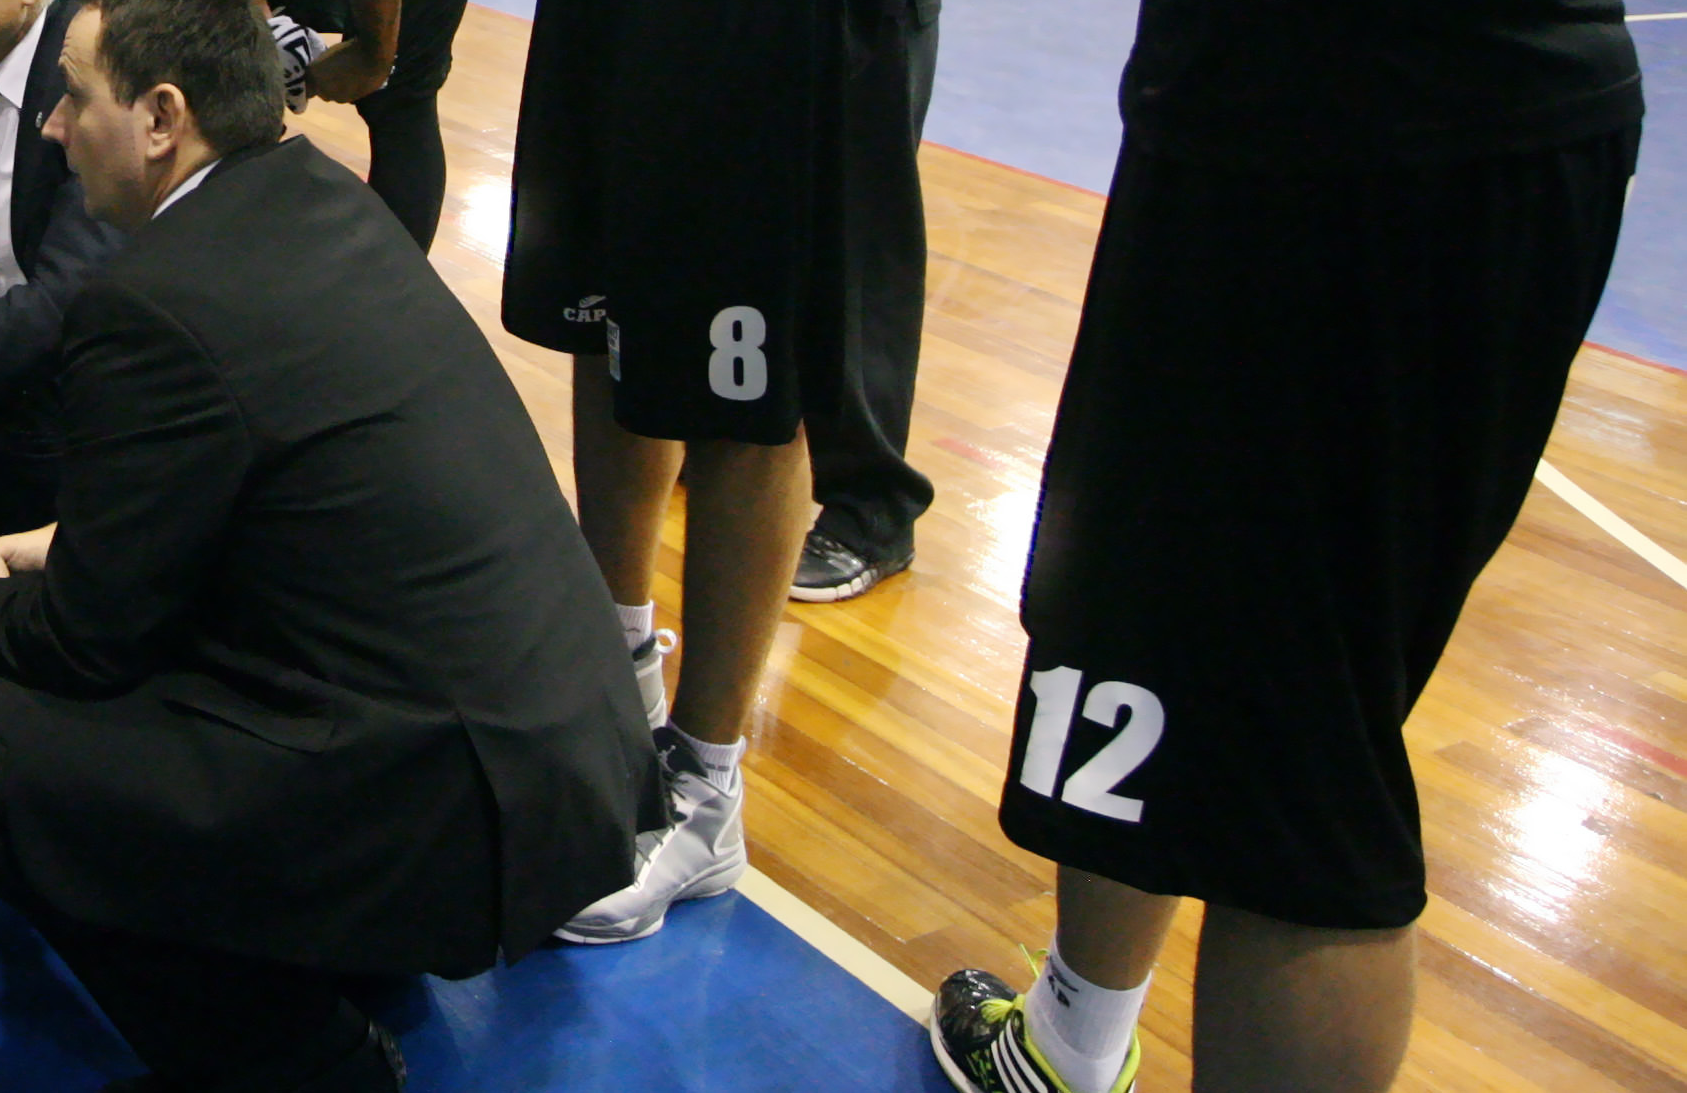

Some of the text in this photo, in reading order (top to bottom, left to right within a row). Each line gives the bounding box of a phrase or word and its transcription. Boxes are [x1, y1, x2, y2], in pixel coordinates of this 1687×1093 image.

[563, 307, 607, 322] CAP
[708, 305, 768, 401] 8
[1019, 664, 1165, 824] 12
